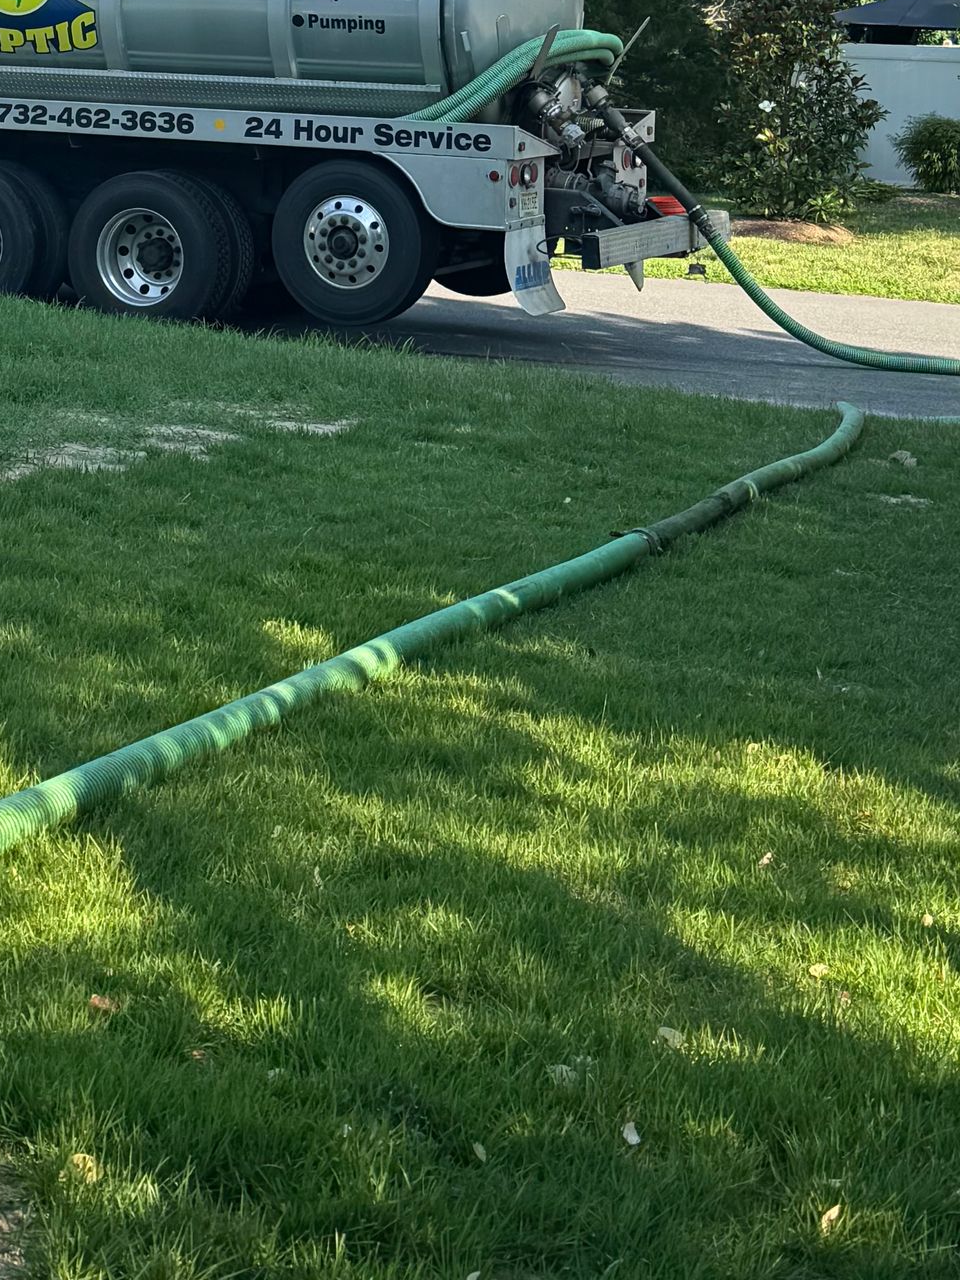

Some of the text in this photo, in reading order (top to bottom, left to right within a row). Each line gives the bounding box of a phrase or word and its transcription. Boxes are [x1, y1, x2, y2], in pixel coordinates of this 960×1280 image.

[308, 13, 385, 35] Pumping
[244, 116, 283, 140] 24
[294, 119, 364, 144] Hour
[374, 123, 492, 152] Service
